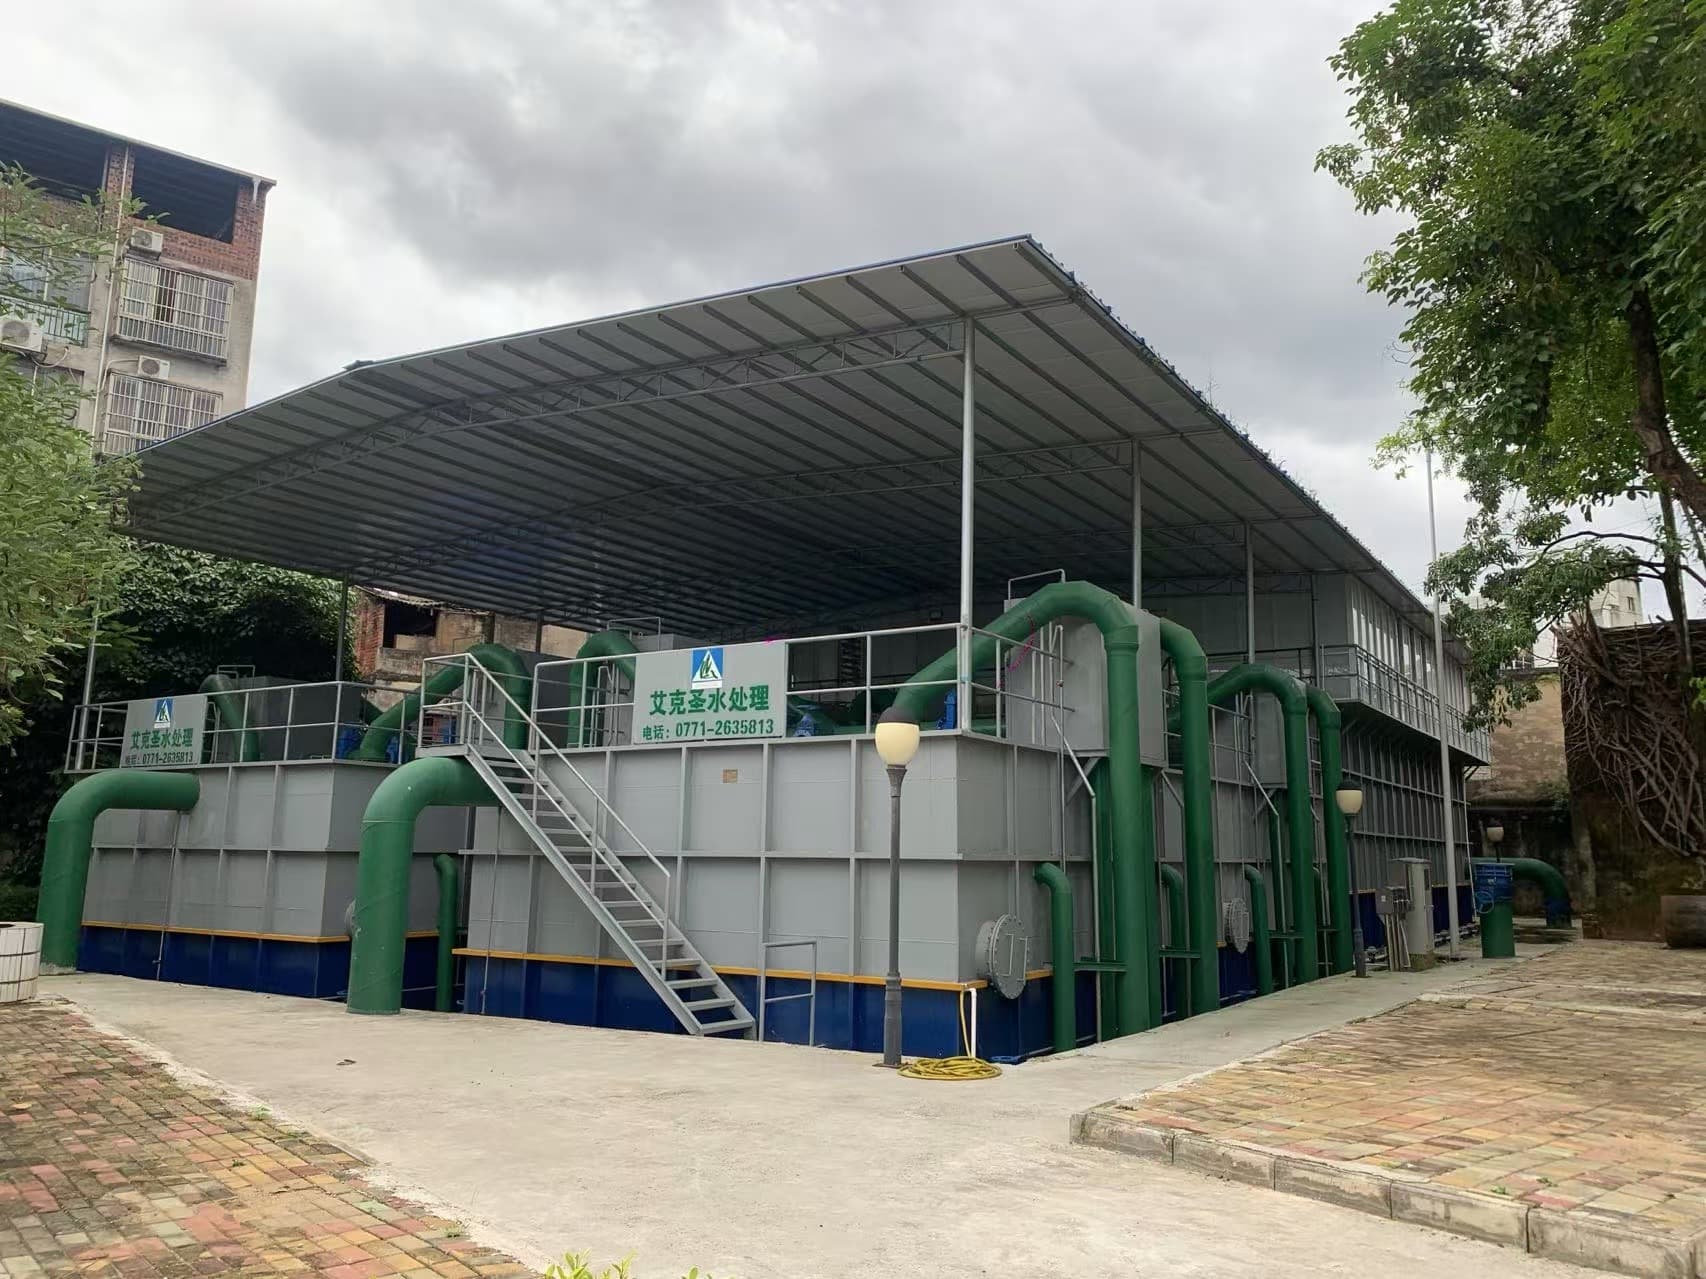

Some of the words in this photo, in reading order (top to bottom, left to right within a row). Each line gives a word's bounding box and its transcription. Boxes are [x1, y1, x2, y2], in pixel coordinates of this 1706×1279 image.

[650, 685, 769, 715] 艾克圣水处理
